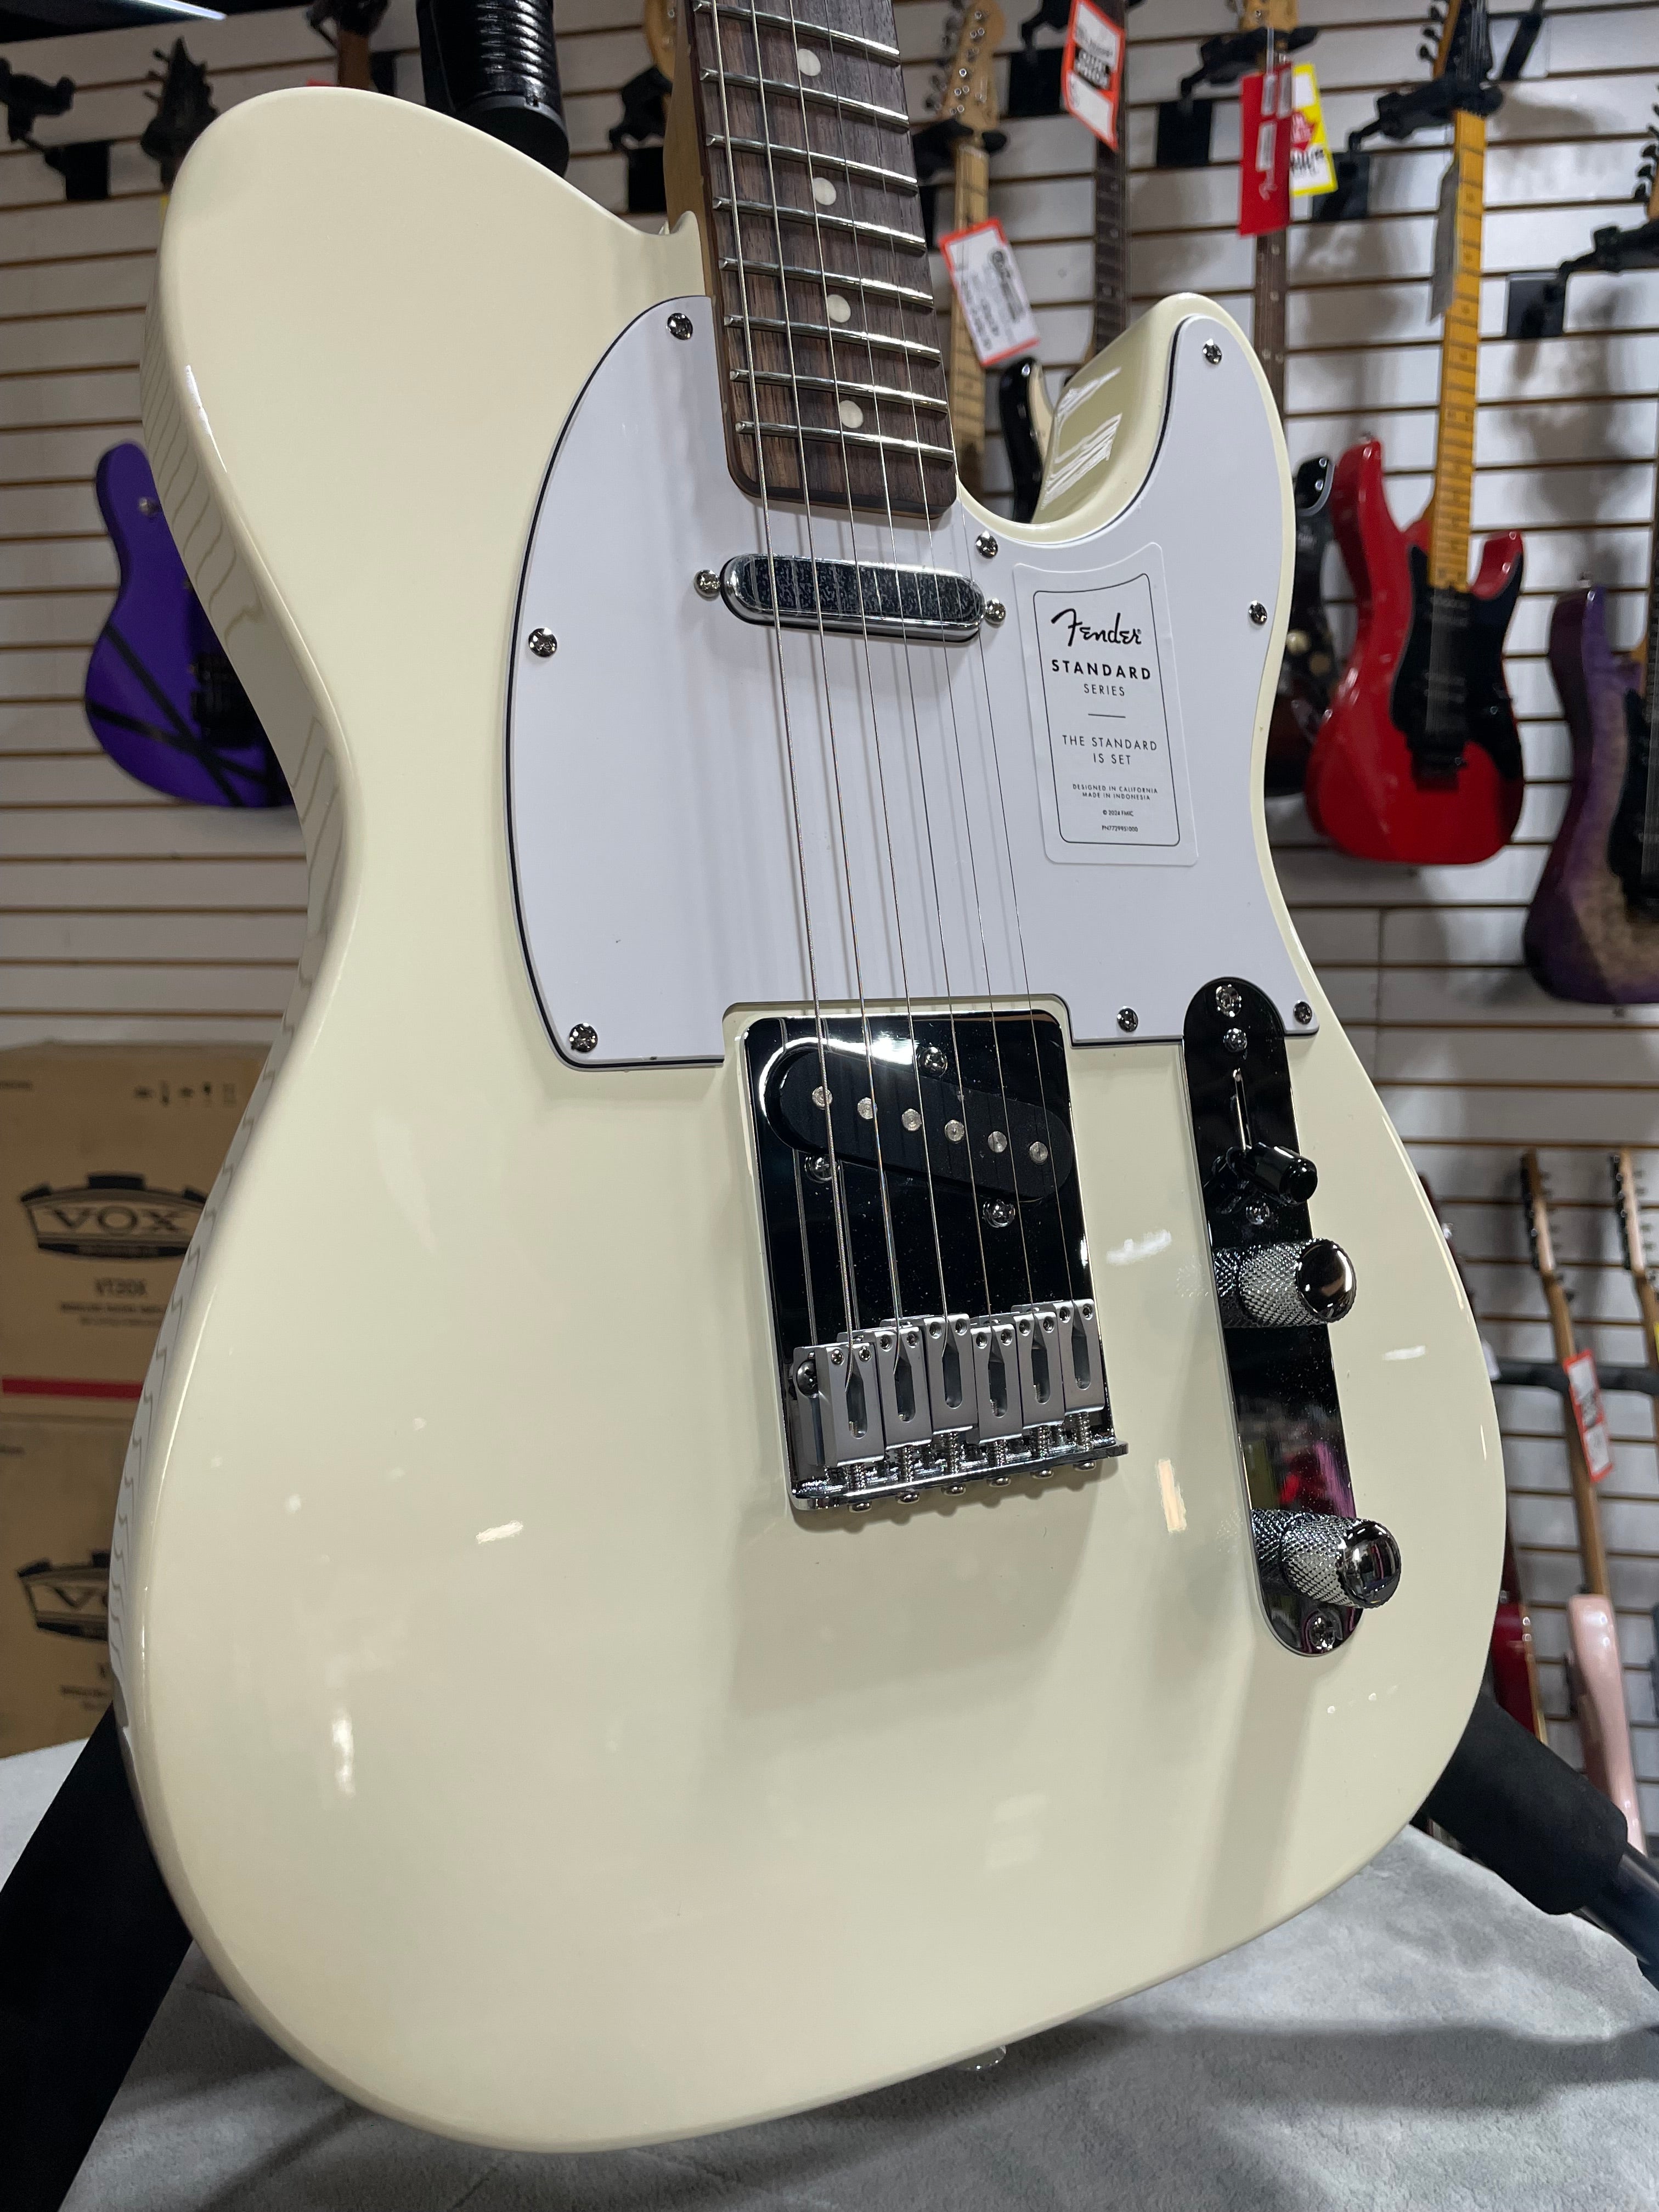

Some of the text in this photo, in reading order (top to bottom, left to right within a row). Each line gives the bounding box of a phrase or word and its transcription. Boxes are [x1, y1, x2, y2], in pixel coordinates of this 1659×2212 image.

[1052, 659, 1150, 680] STANDARD
[1084, 684, 1125, 696] SERIES
[1062, 735, 1156, 751] THE STANDARD
[1093, 753, 1131, 765] IS SET
[1119, 786, 1158, 794] CALIFORNIA
[46, 1205, 179, 1234] VOX
